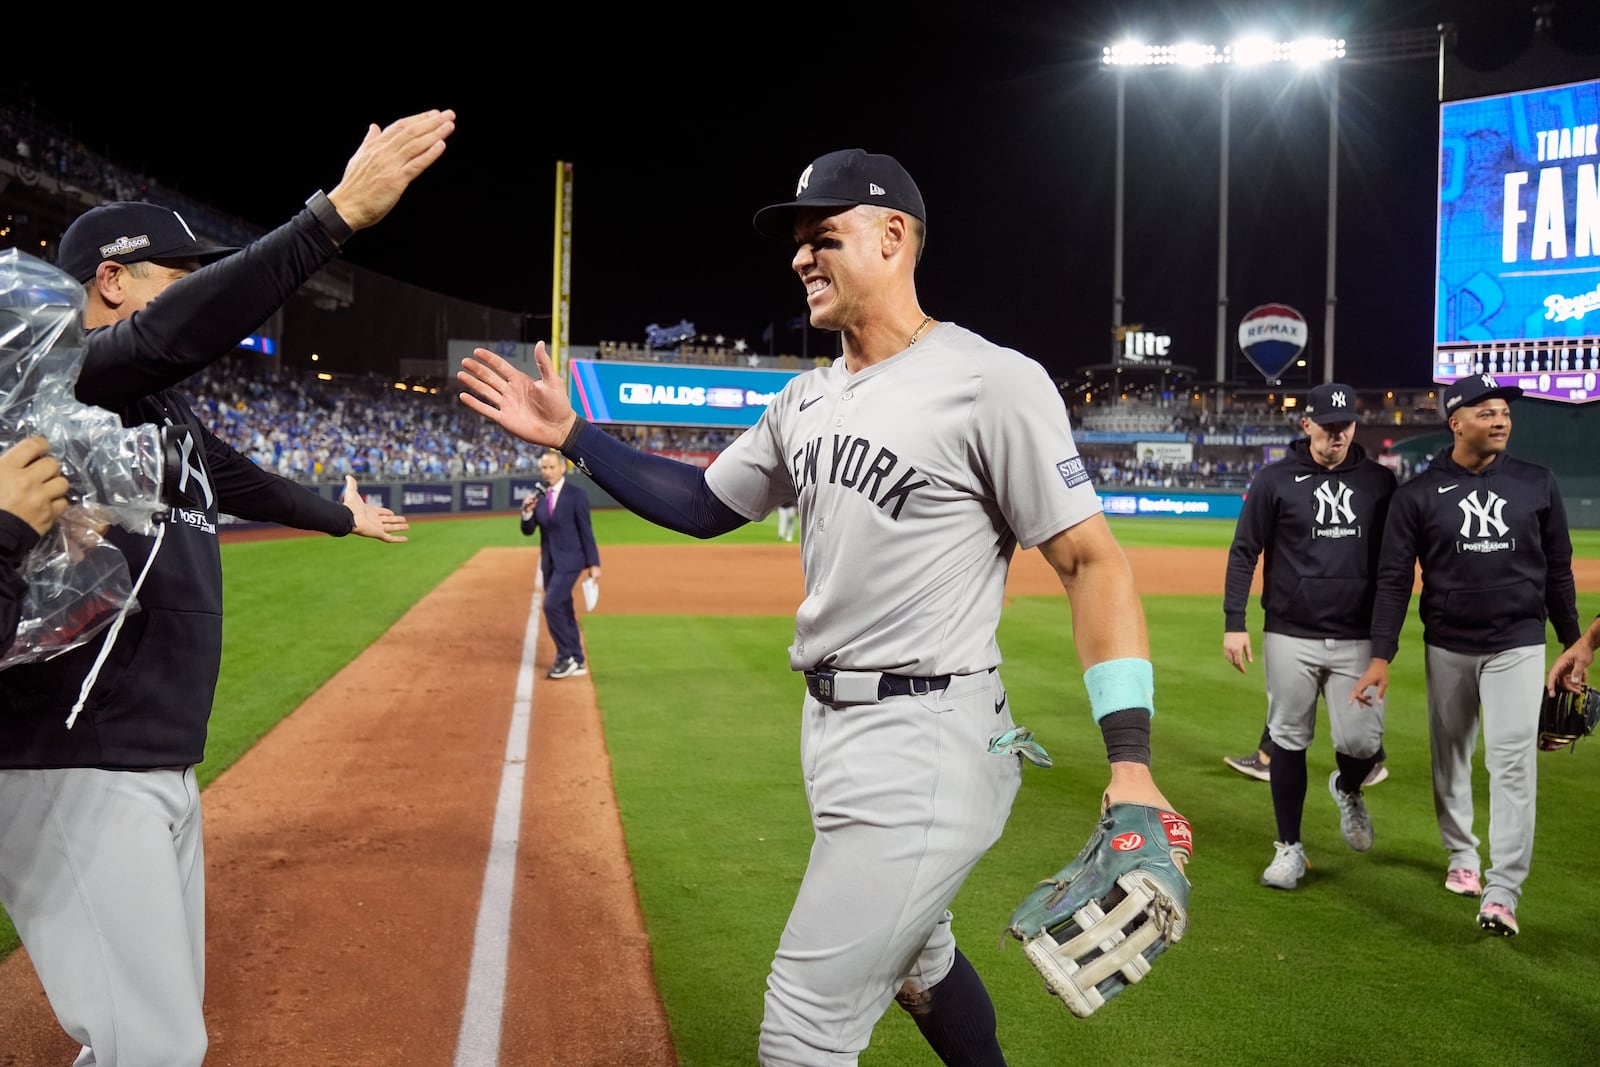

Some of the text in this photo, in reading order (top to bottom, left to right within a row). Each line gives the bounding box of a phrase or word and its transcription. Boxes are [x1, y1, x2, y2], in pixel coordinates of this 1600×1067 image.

[1536, 124, 1598, 162] THANK
[102, 237, 148, 255] POSTSEASON
[1247, 323, 1298, 338] RE/MAX
[1124, 331, 1172, 361] Lite
[652, 385, 706, 406] ALDS
[1331, 391, 1347, 408] NY
[791, 434, 931, 521] EW YORK
[1139, 497, 1209, 514] Booking.com
[1313, 479, 1358, 525] NY
[1458, 489, 1510, 539] NY
[1316, 528, 1357, 538] POSTSEASON
[1462, 542, 1510, 552] POSTSEASON
[819, 679, 831, 697] 99
[1114, 834, 1142, 850] R
